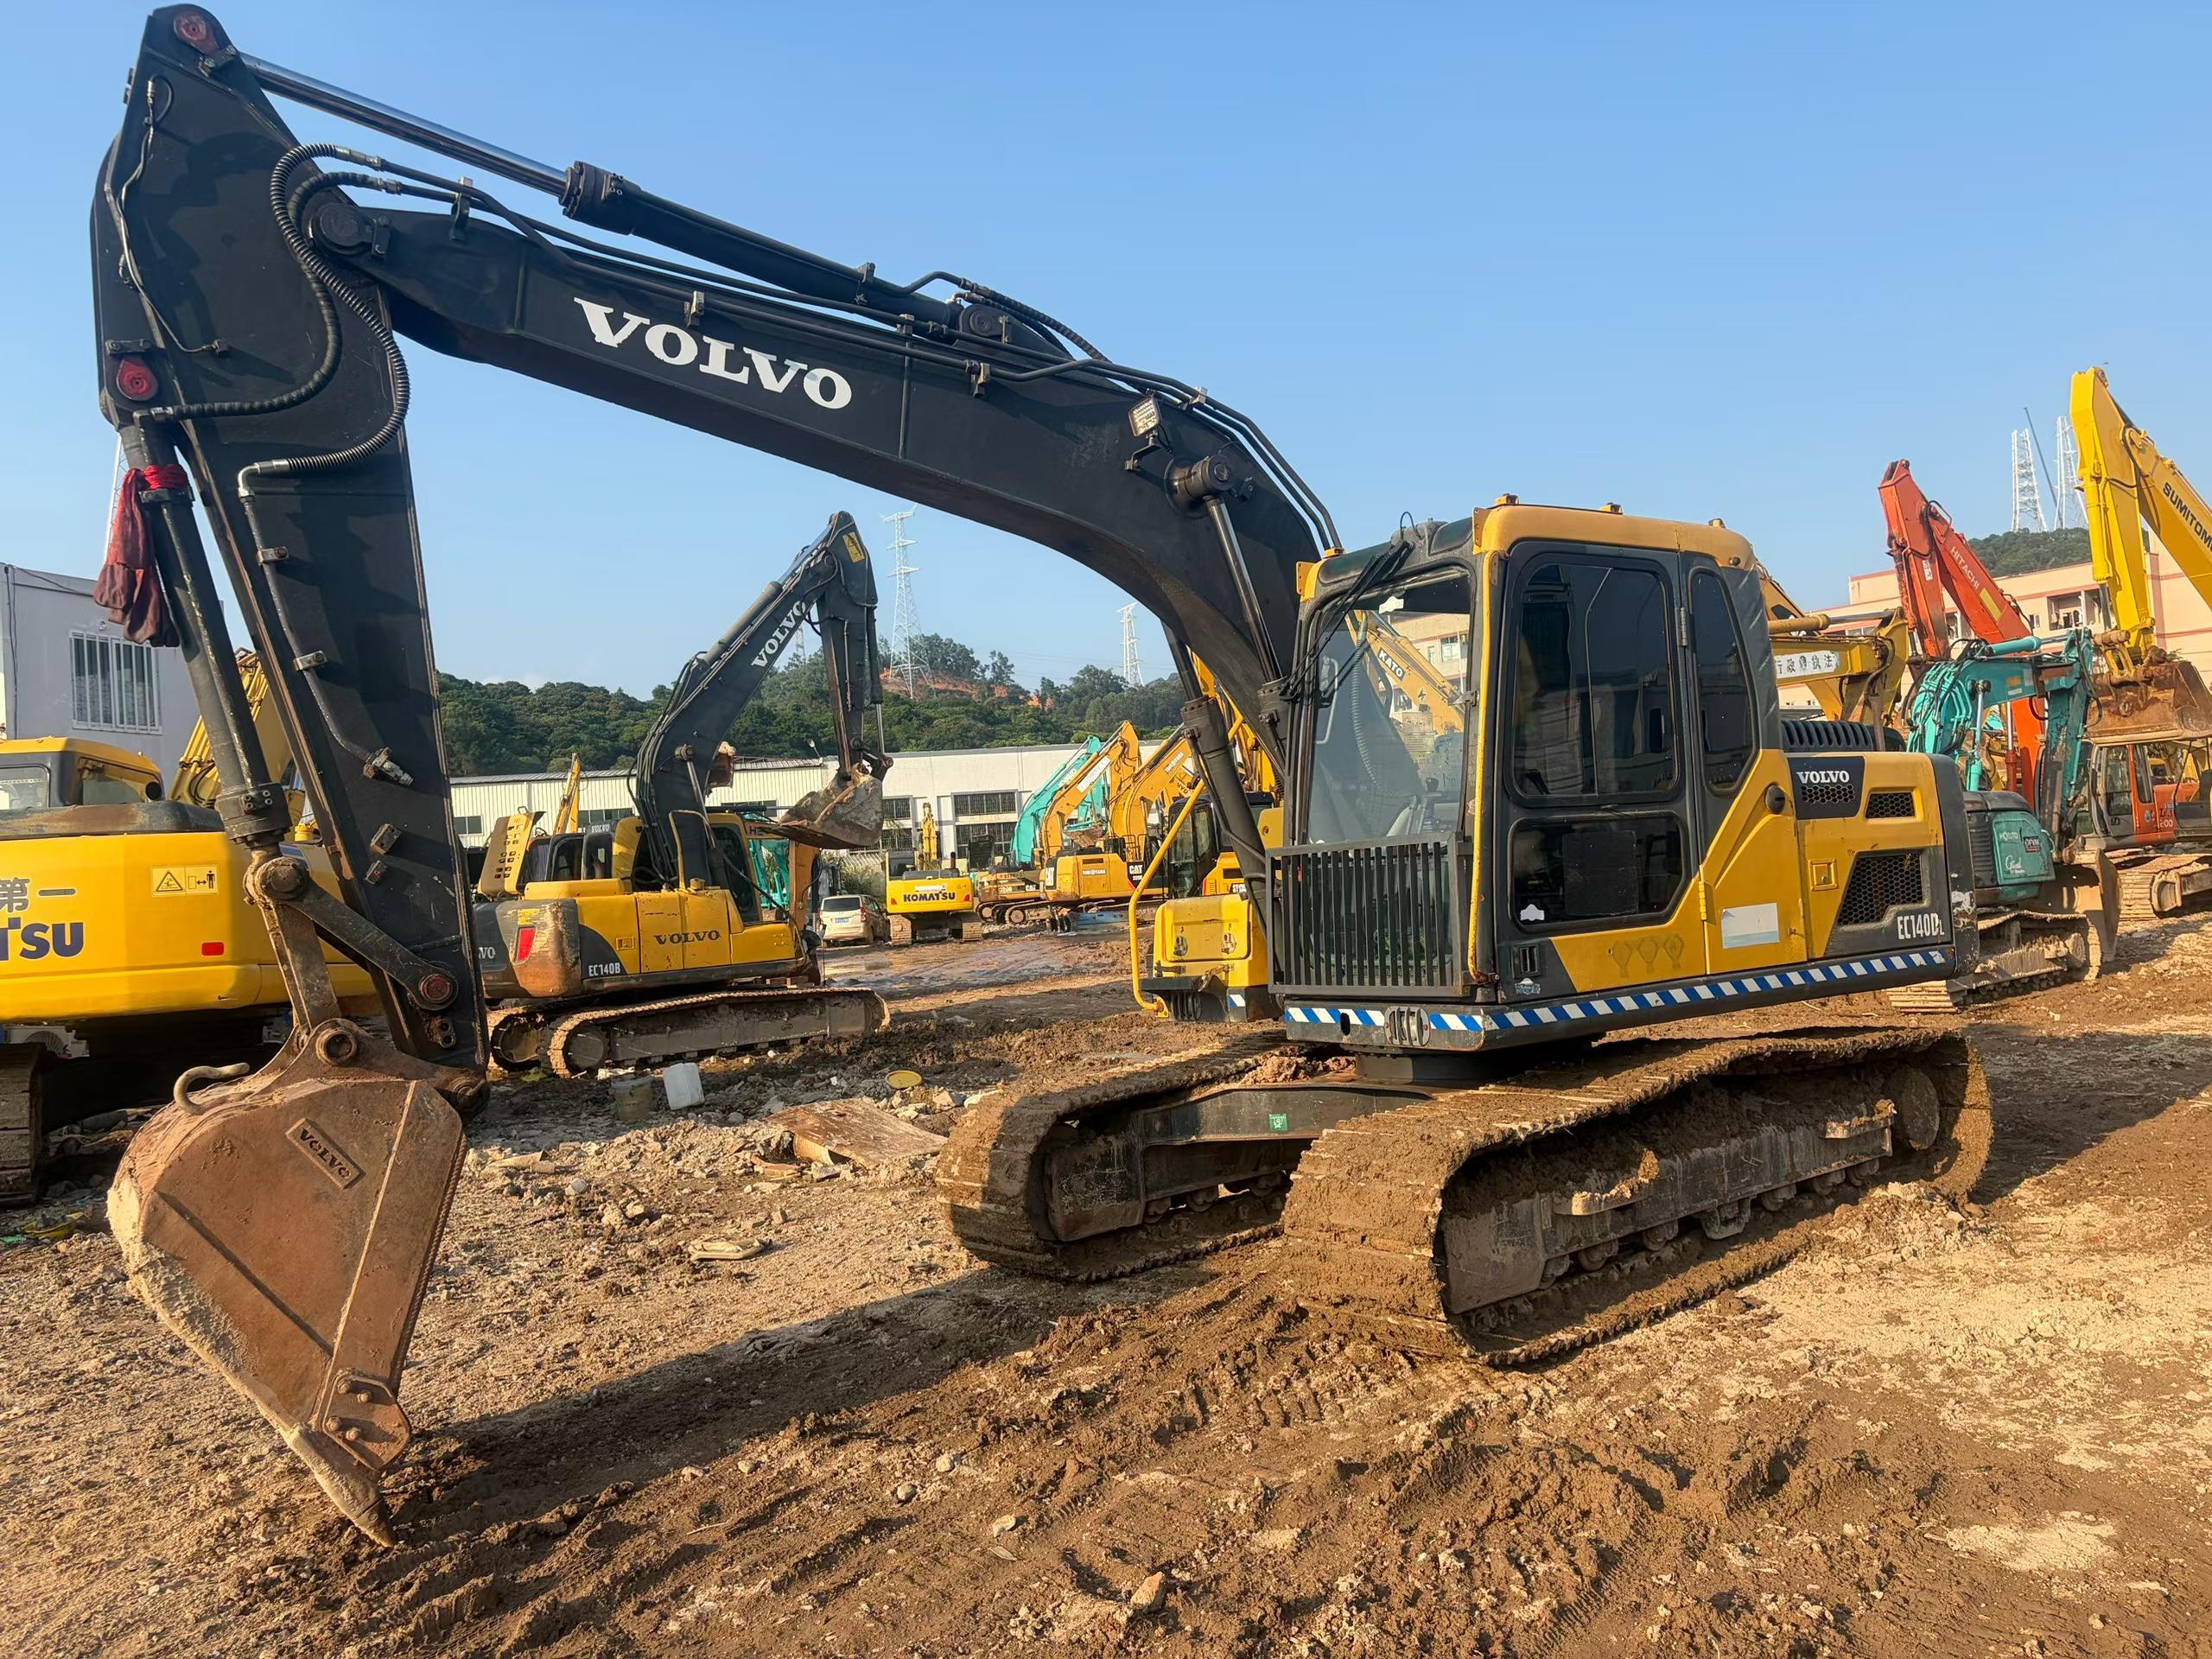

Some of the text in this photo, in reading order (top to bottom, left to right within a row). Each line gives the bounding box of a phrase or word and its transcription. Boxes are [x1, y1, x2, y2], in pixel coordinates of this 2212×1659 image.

[574, 297, 852, 410] VOLVO
[2163, 482, 2212, 552] SUMITOM
[1950, 546, 1980, 589] HITACHI
[751, 601, 806, 668] VOLVO
[1378, 650, 1403, 677] KATO
[1796, 770, 1850, 784] VOLVO
[1128, 865, 1143, 874] CAT
[903, 892, 956, 903] KOMATSU
[653, 929, 721, 945] VOLVO
[588, 962, 621, 977] EC140B
[300, 1127, 351, 1179] VOLVO
